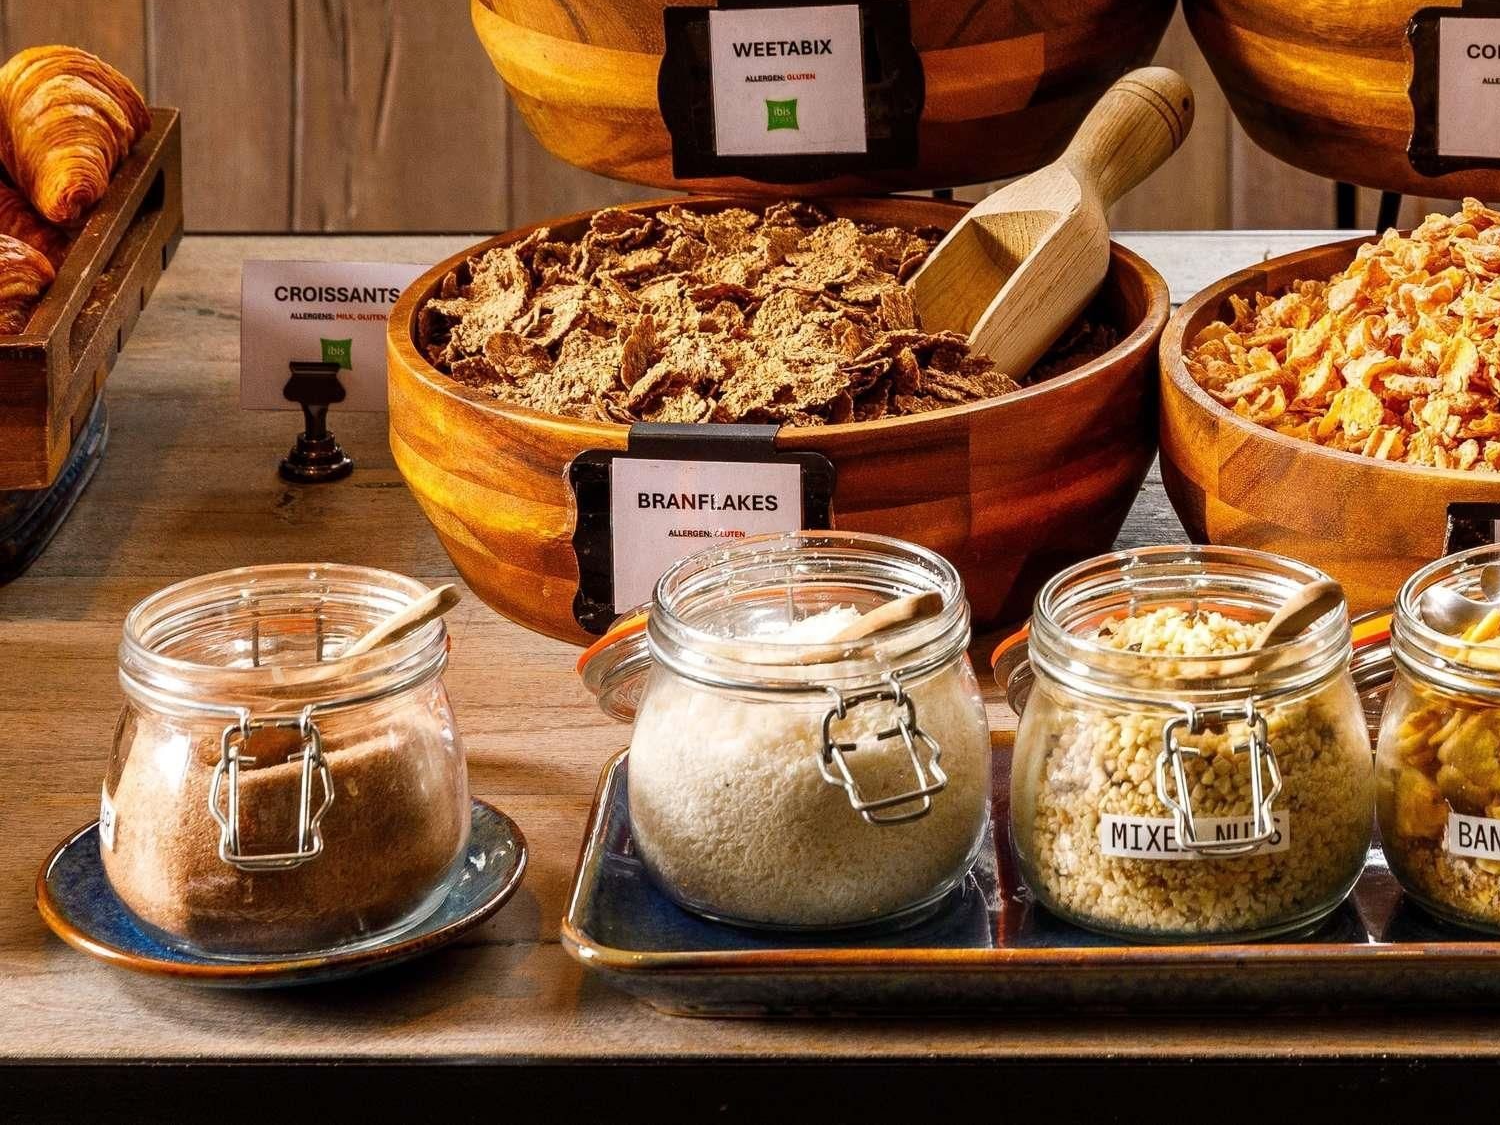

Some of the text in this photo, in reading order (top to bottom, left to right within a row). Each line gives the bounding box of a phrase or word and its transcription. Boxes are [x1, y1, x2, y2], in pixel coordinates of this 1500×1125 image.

[733, 39, 832, 57] WEETABIX
[745, 73, 816, 83] ALLERGEN: GLUTEN
[773, 106, 791, 116] ibis
[274, 286, 400, 303] CROISSANTS
[290, 313, 335, 321] ALLERGENS:
[328, 346, 345, 356] ibis
[638, 493, 778, 511] BRANFLAKES
[668, 529, 712, 537] ALLERGEN:
